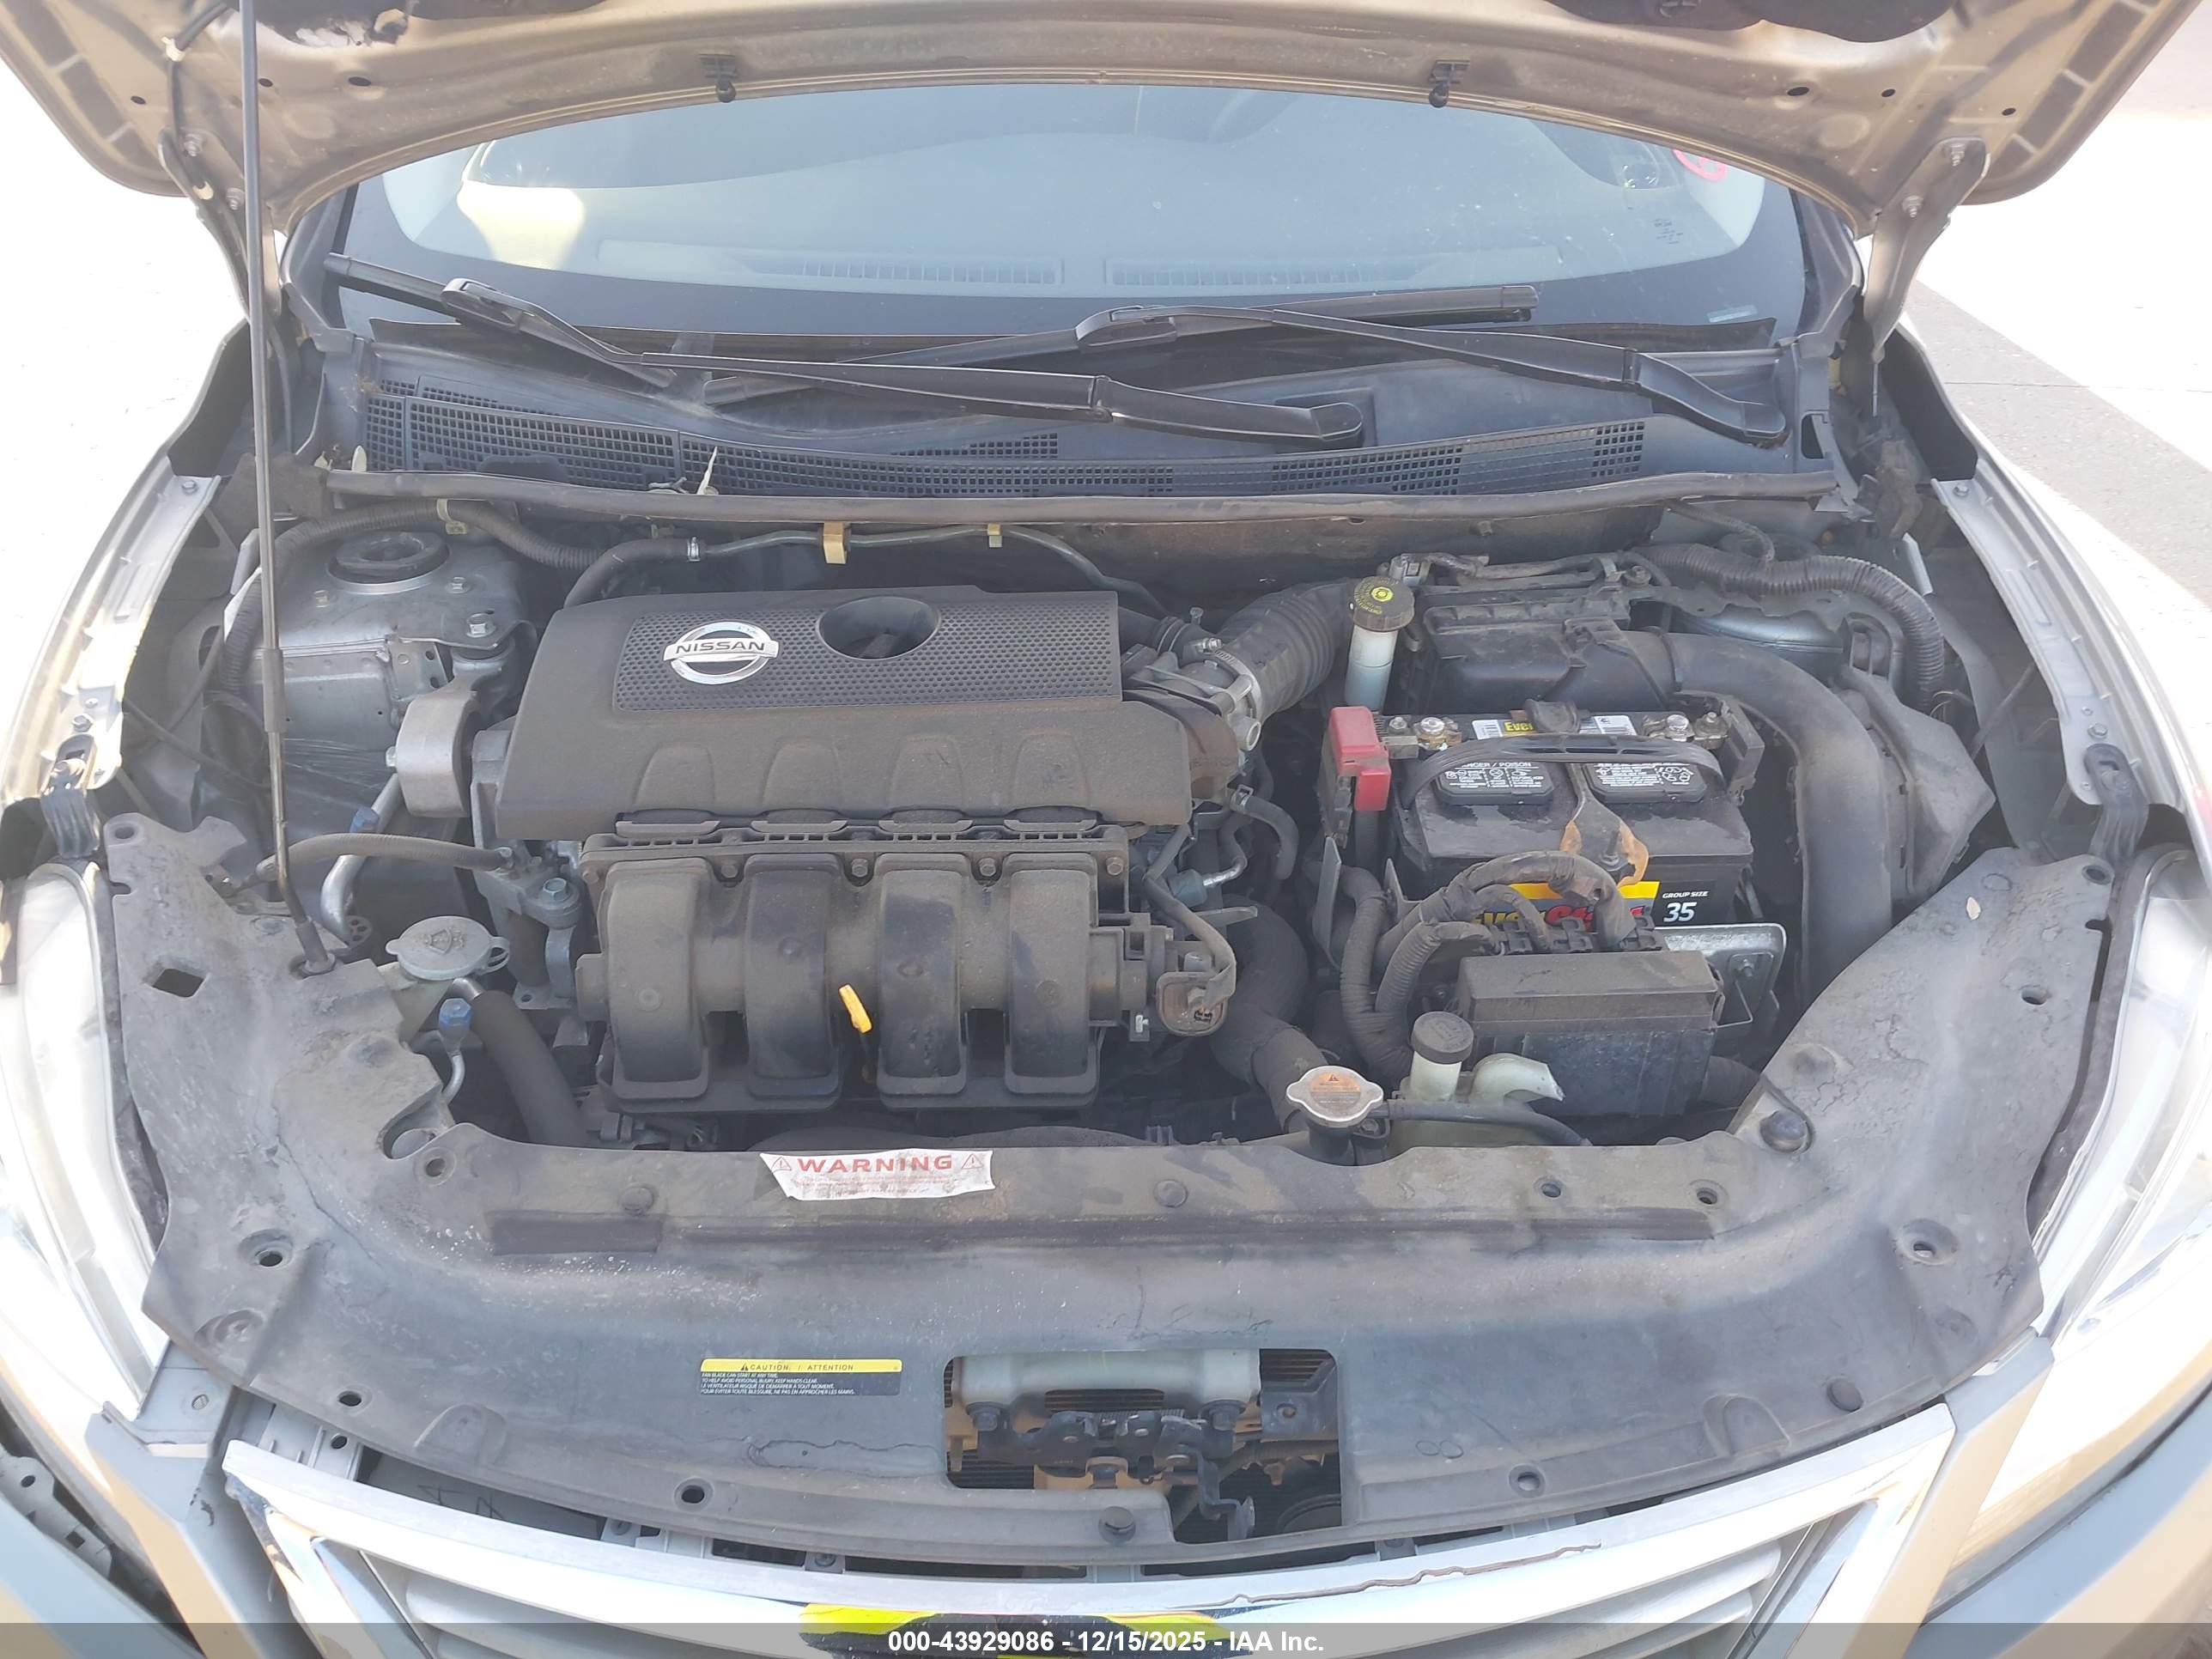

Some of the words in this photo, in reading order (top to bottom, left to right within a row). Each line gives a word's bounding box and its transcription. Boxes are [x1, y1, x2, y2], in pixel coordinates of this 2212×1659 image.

[676, 641, 764, 653] NISSAN
[1662, 890, 1690, 899] GROUP
[1663, 902, 1698, 923] 35
[797, 1155, 952, 1173] WARNING
